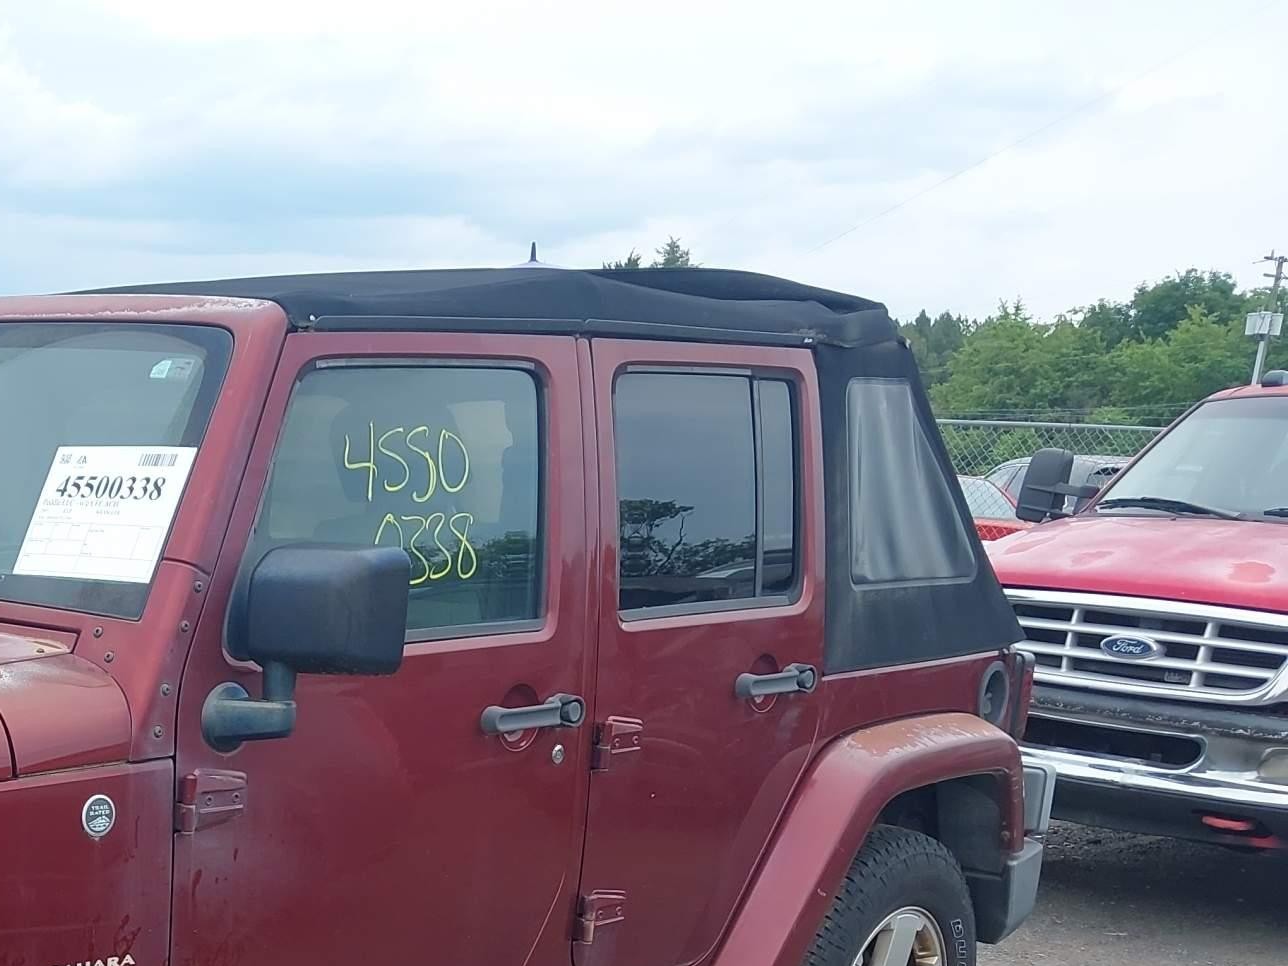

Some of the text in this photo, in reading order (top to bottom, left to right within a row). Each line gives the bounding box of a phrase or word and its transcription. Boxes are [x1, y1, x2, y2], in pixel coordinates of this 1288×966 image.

[344, 420, 470, 502] 4550
[55, 475, 167, 501] 45500338
[1112, 638, 1145, 655] Ford
